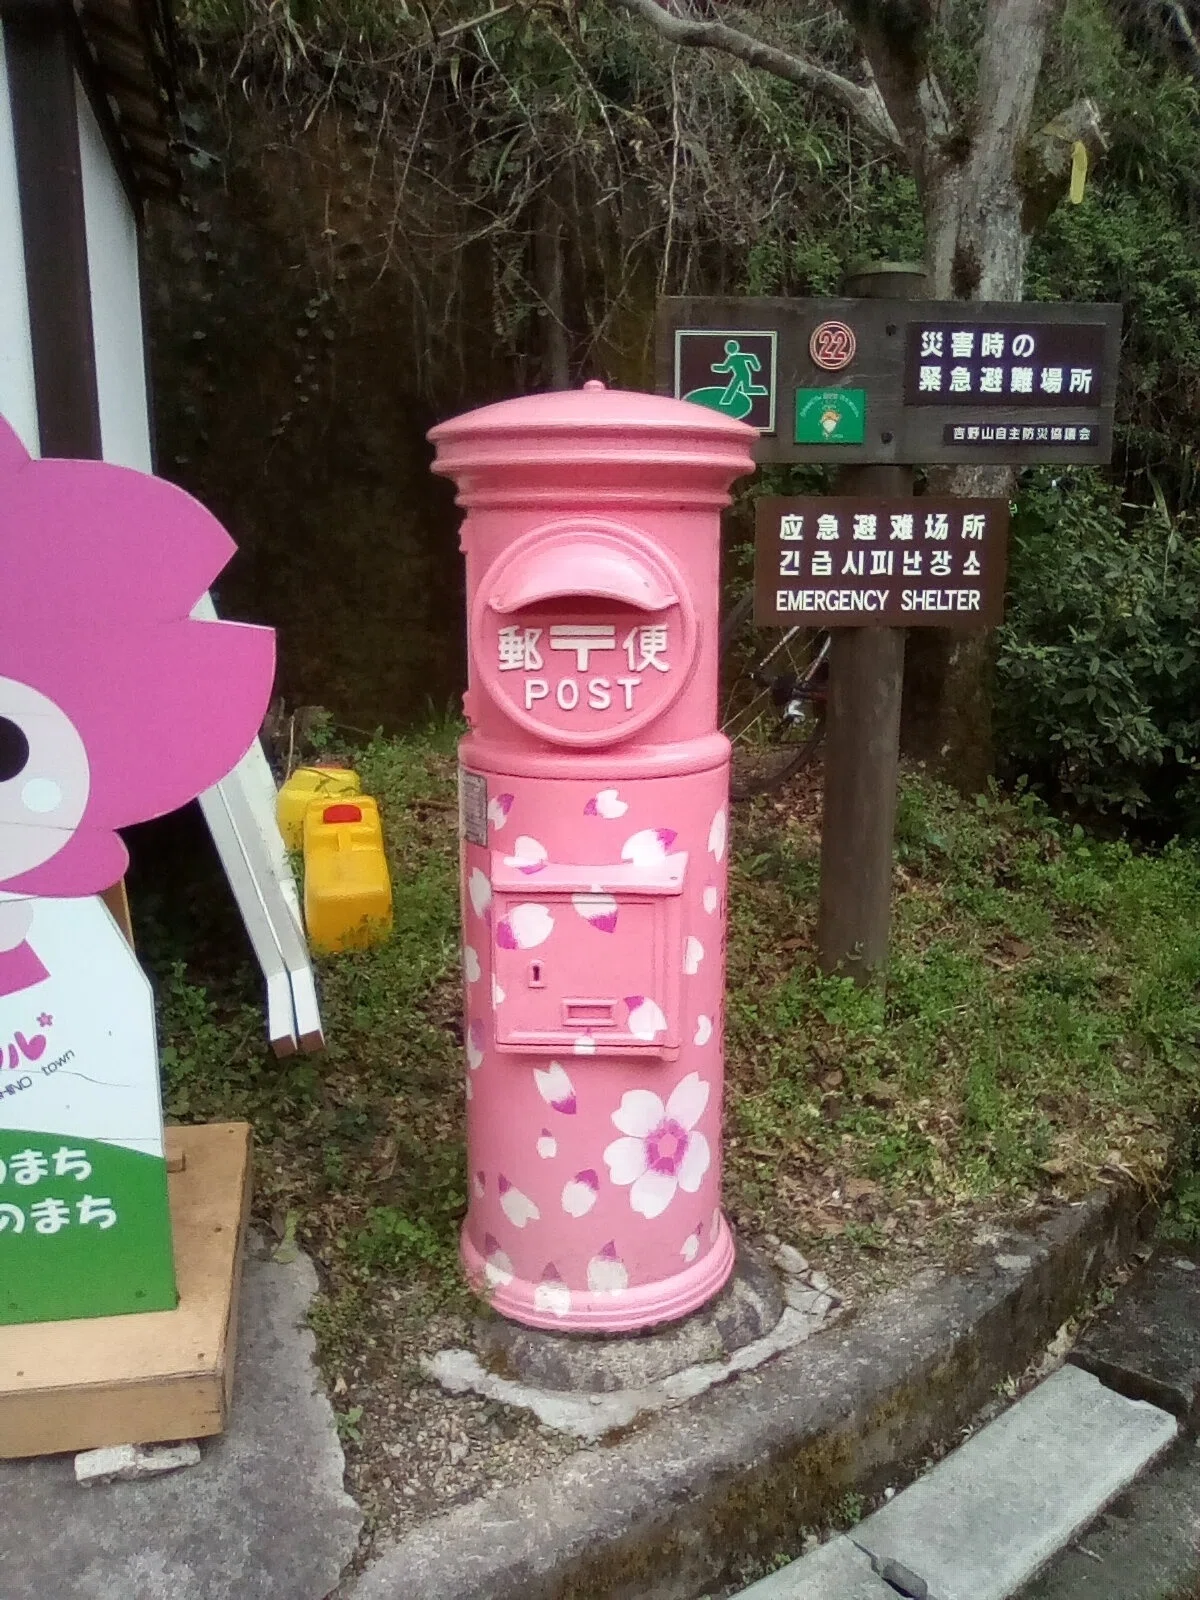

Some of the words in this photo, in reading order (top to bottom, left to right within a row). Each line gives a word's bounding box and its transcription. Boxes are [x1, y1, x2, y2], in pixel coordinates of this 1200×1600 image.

[819, 330, 847, 360] 22
[920, 331, 1035, 358] 災害時の
[918, 366, 1092, 393] 緊急避難場所
[780, 514, 986, 540] 应急避难场所
[776, 590, 890, 611] EMERGENCY
[901, 590, 981, 611] SHELTER
[524, 677, 642, 710] POST
[41, 1049, 76, 1076] town
